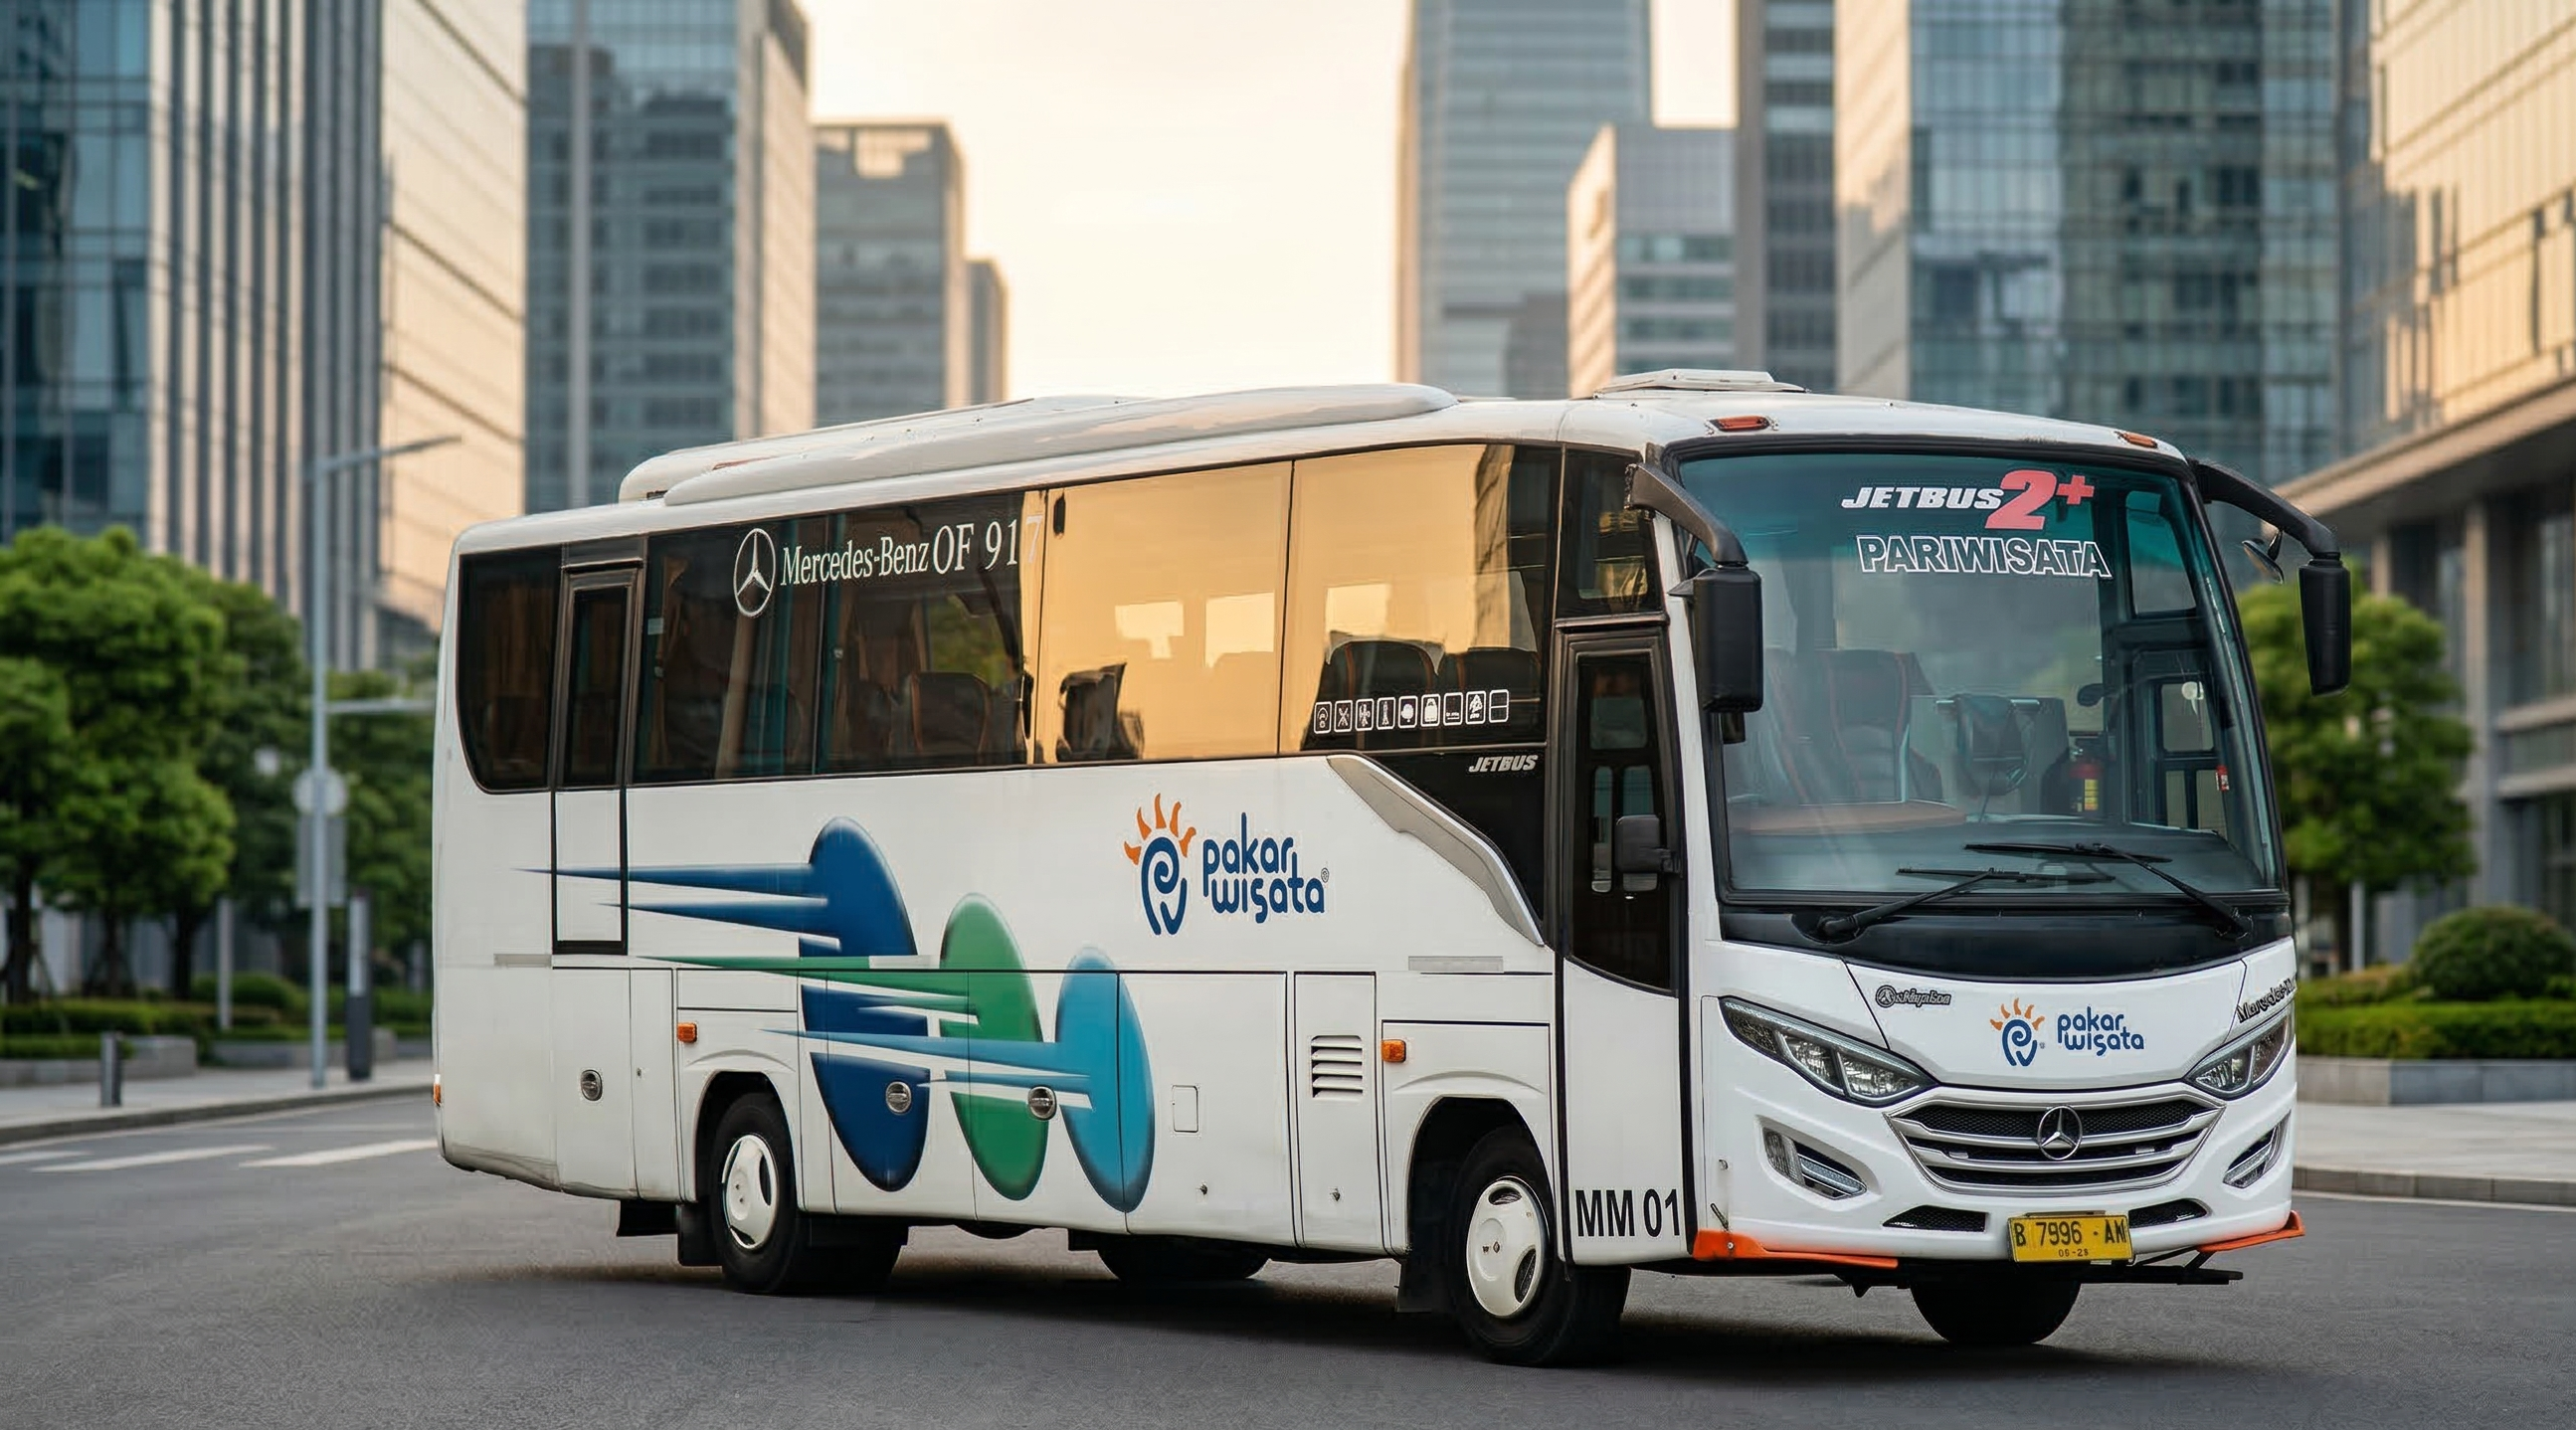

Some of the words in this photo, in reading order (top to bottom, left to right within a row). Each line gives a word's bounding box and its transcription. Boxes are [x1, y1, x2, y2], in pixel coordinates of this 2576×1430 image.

[780, 535, 930, 587] Mercedes-Benz
[933, 523, 975, 575] OF
[985, 514, 1043, 571] 917
[1856, 534, 2114, 579] PARIWISATA
[1468, 754, 1539, 774] JETBUS
[1202, 811, 1294, 898] pakar
[1210, 851, 1325, 924] wisata
[2058, 1005, 2124, 1044] pakar
[2064, 1025, 2145, 1057] wisata
[1574, 1188, 1636, 1237] MM
[1643, 1188, 1681, 1238] 01
[2014, 1222, 2027, 1247] B
[2035, 1220, 2083, 1246] 7996
